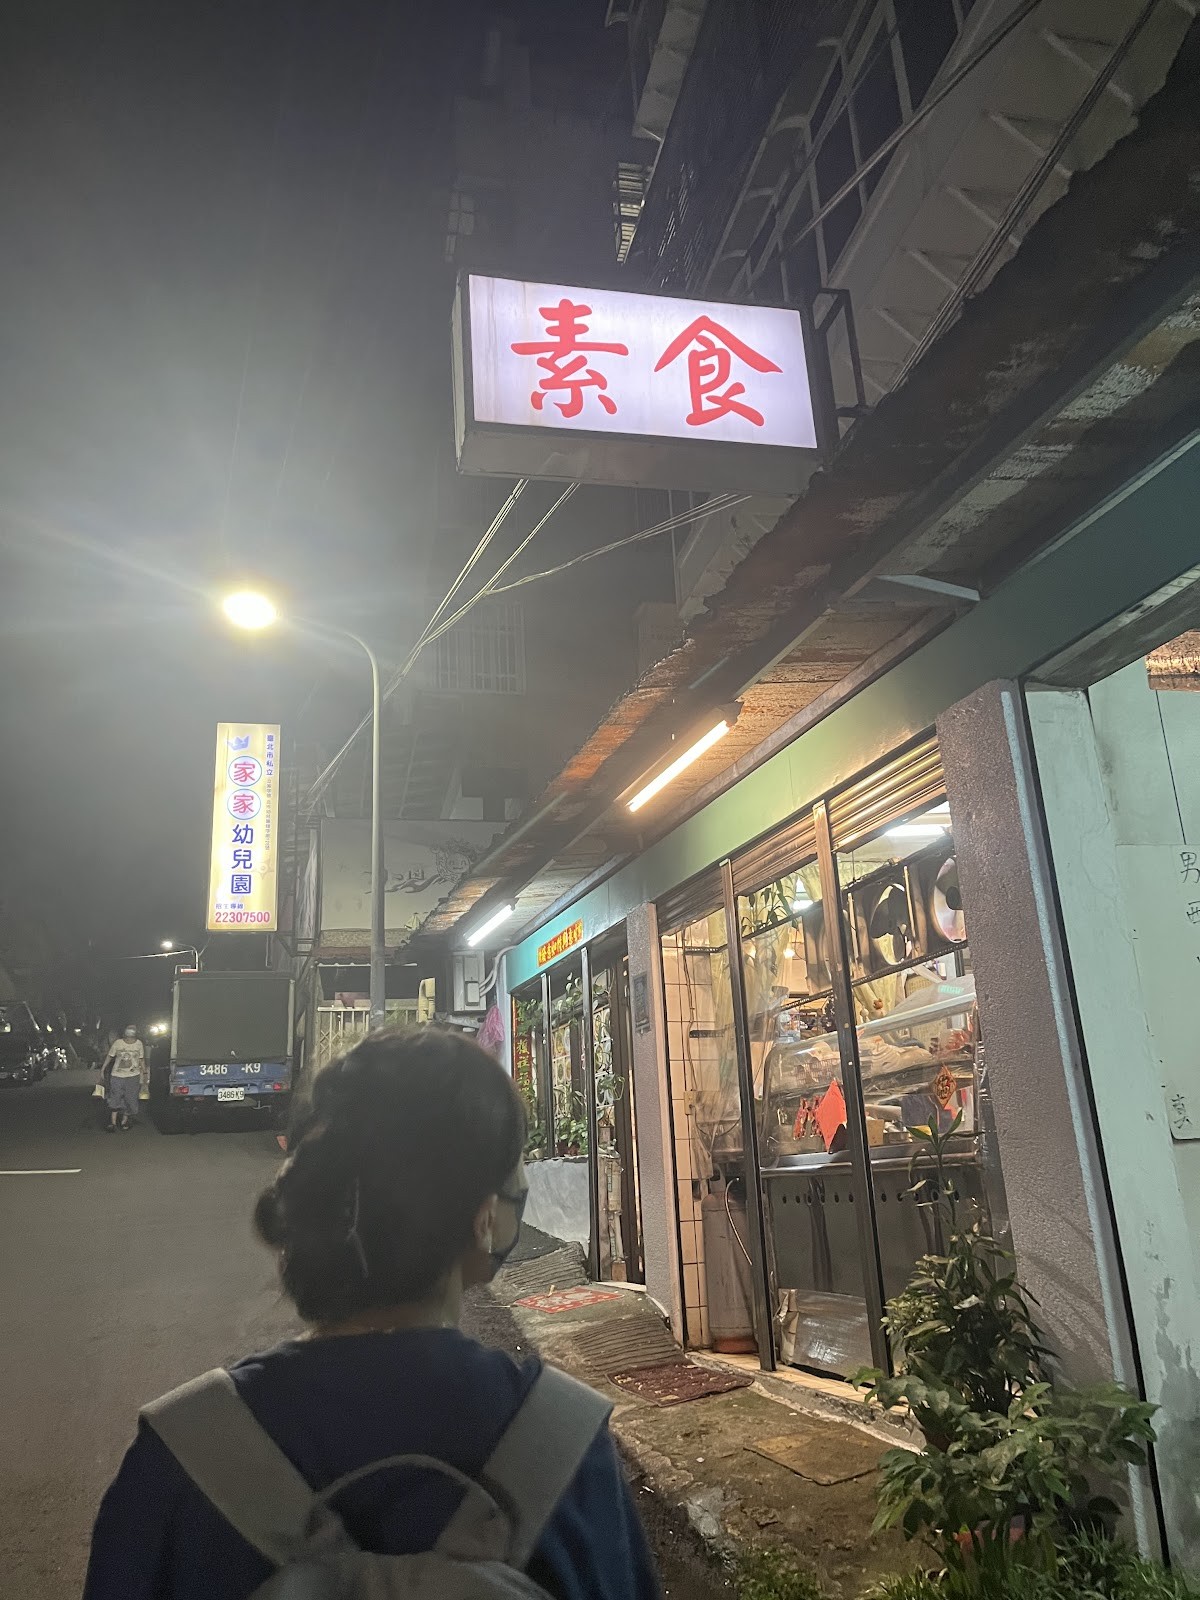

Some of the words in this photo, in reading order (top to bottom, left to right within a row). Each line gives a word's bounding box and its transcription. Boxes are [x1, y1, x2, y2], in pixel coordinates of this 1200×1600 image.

[511, 298, 783, 427] 素食
[230, 761, 256, 894] 家家幼兒園
[215, 911, 270, 923] 22307500
[199, 1064, 228, 1076] 3486
